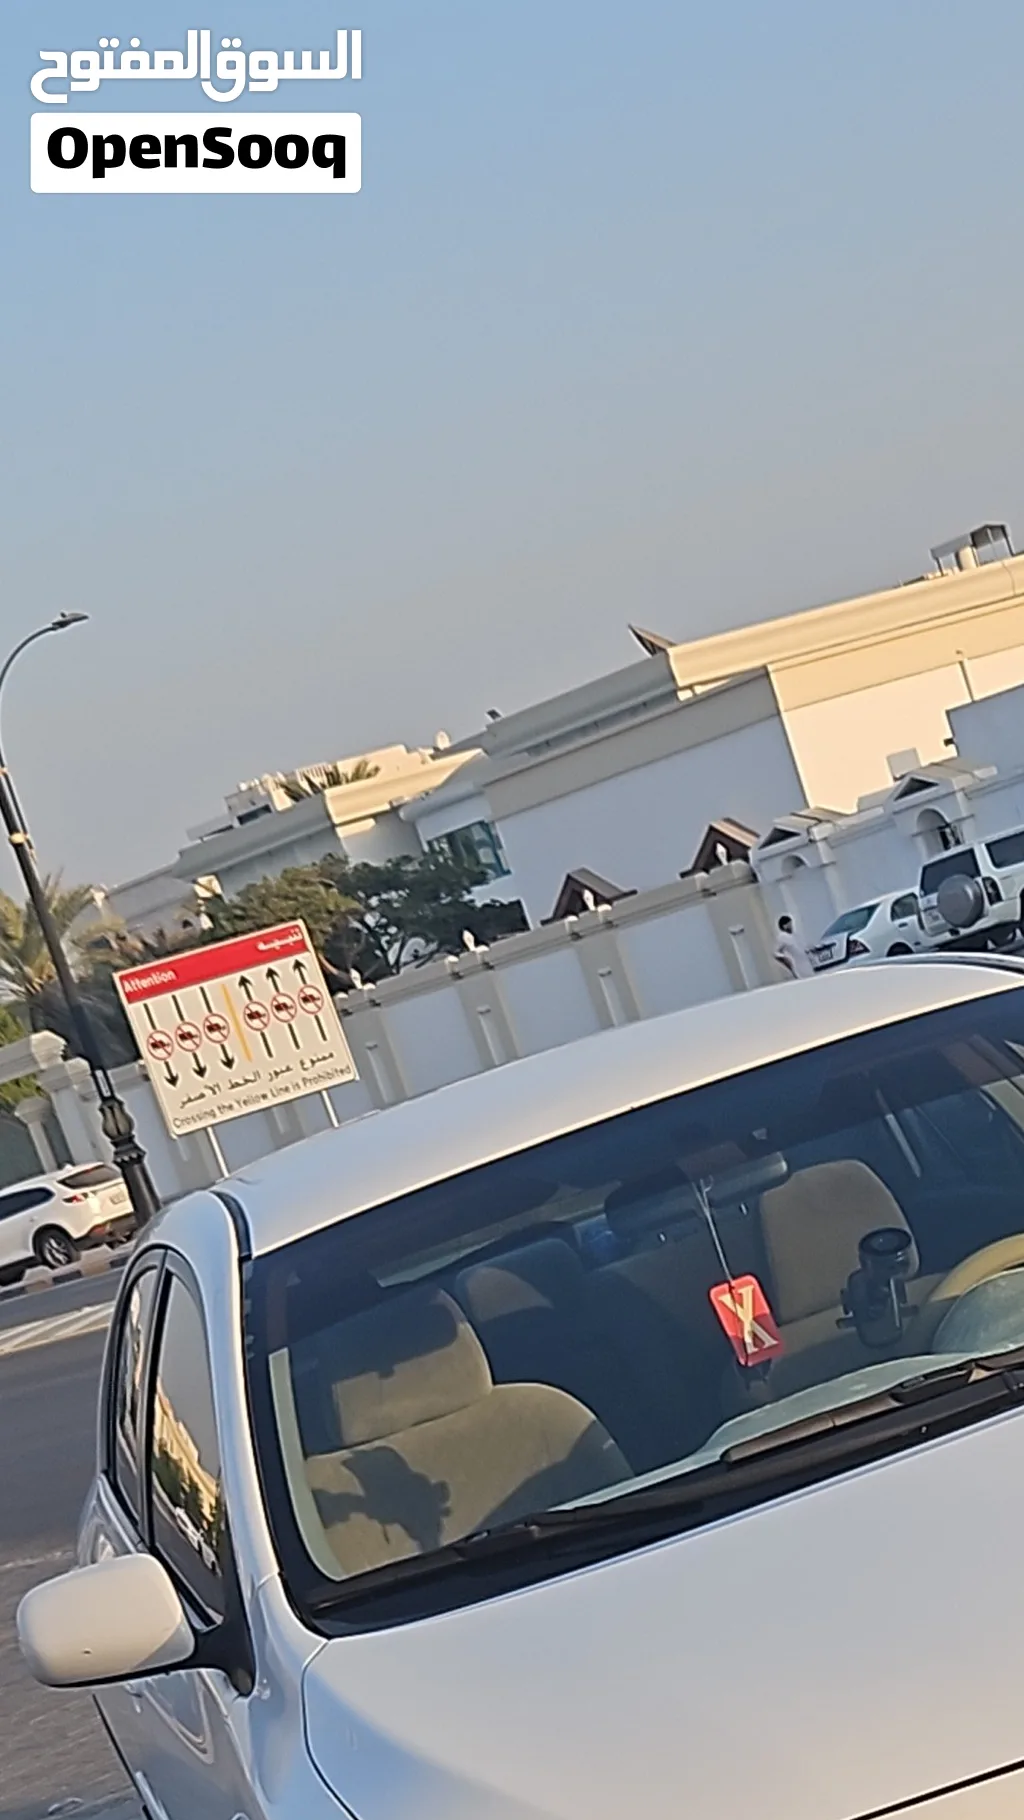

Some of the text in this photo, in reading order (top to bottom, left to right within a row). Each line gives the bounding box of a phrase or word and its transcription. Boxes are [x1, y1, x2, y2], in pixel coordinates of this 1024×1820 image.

[256, 928, 303, 951] تنبيه
[123, 970, 176, 993] Attention
[299, 1052, 335, 1071] ممنوع
[227, 1071, 261, 1090] الخط
[267, 1065, 293, 1082] عبور
[172, 1064, 352, 1129] Crossing the Yellow Line is Prohibited
